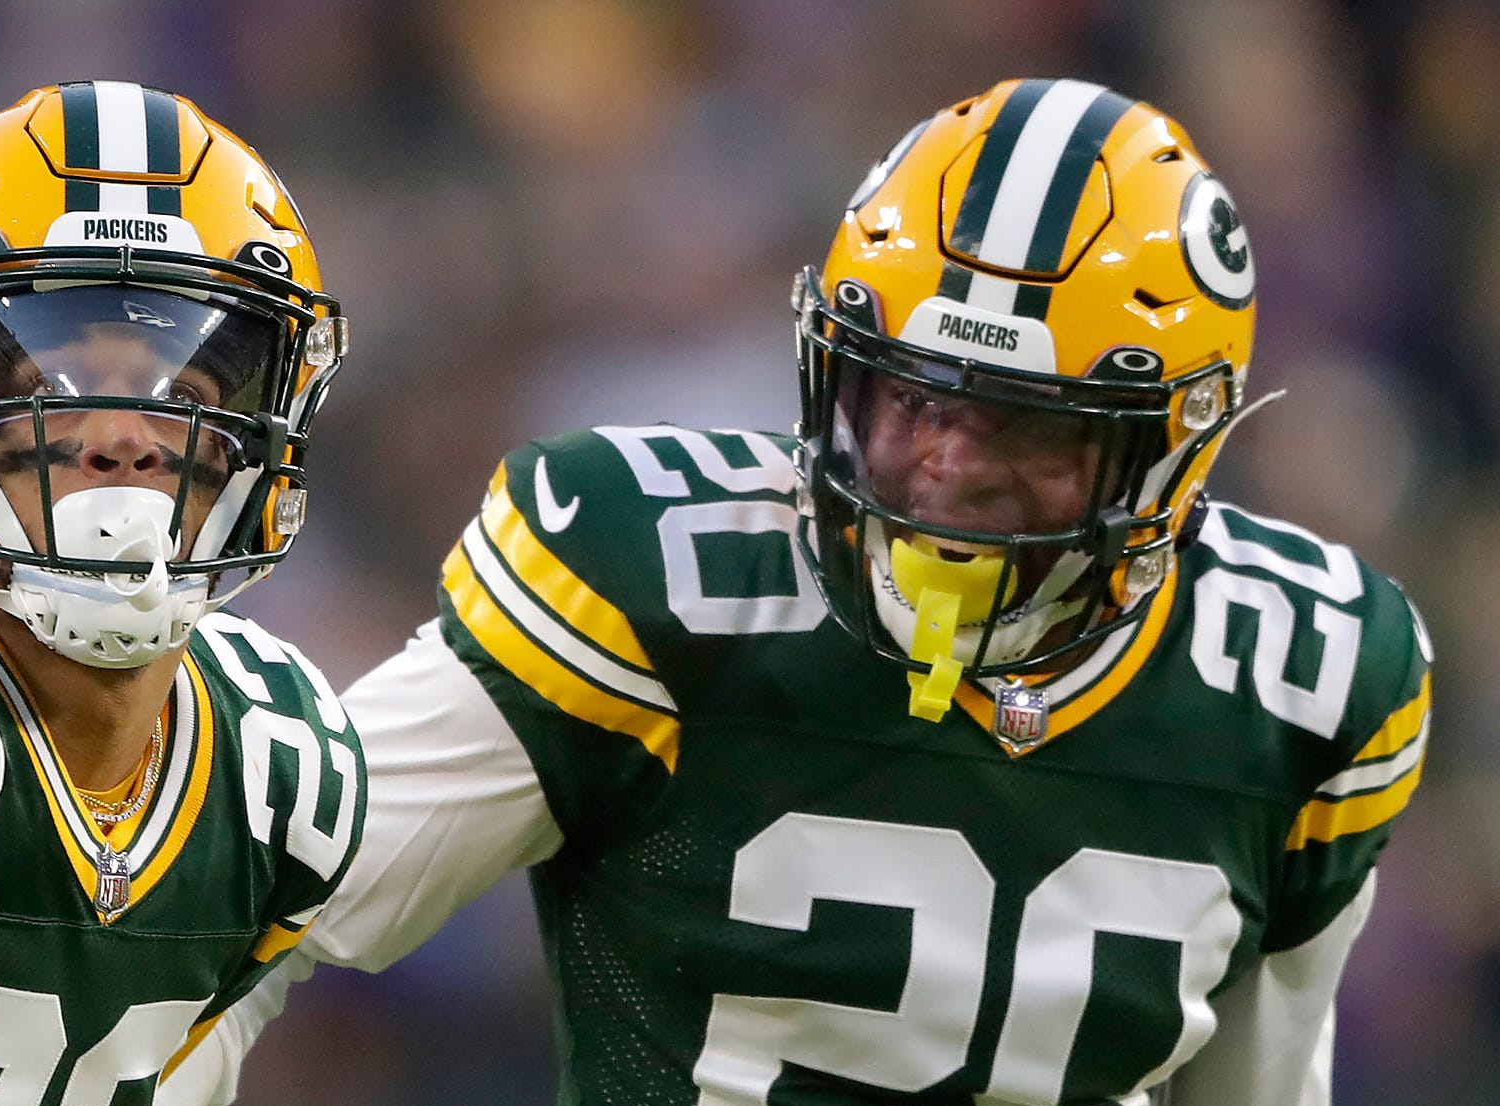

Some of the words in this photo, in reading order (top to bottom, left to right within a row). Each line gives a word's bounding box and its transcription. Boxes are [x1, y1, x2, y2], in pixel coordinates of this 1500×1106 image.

[84, 218, 168, 243] PACKERS
[938, 313, 1019, 352] PACKERS
[591, 425, 830, 635] 20
[1190, 501, 1365, 741] 20
[1001, 708, 1038, 737] NFL
[100, 878, 127, 907] NFL
